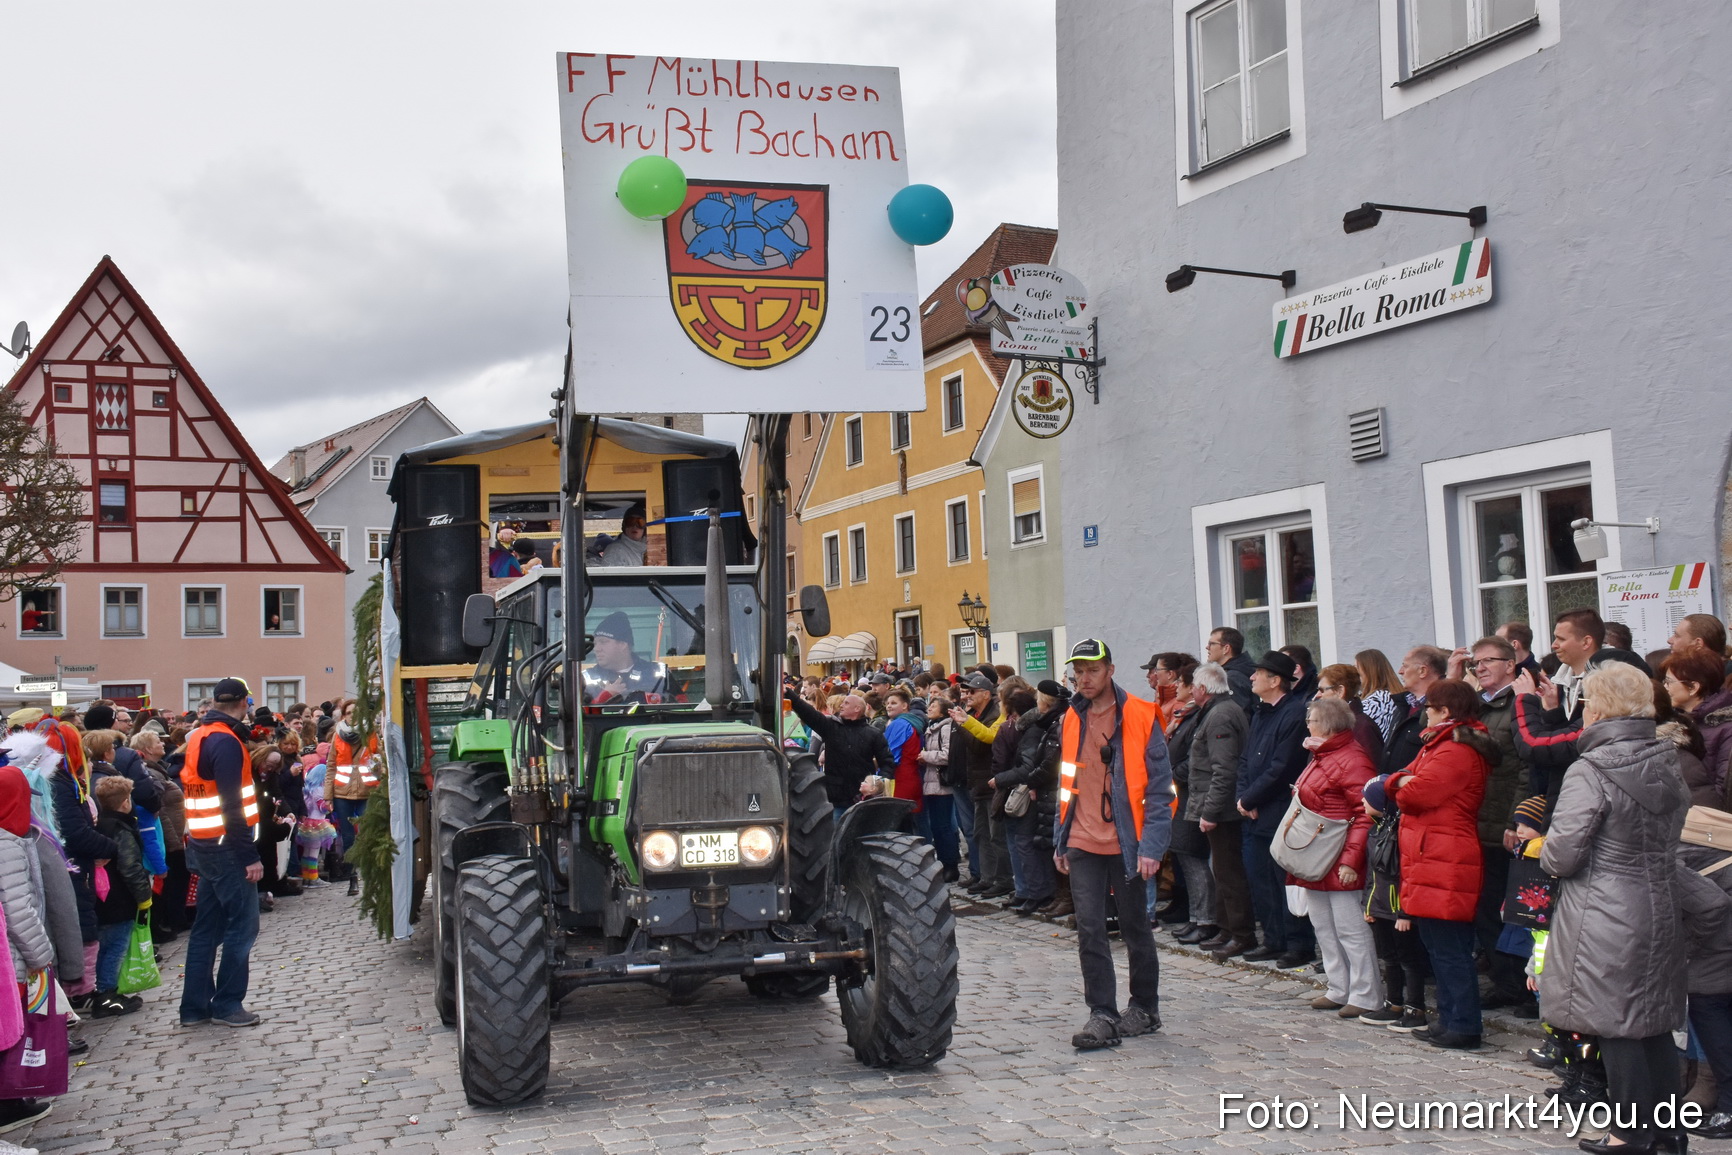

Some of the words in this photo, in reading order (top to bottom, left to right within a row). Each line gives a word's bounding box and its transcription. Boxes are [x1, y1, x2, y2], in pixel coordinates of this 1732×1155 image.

[647, 56, 879, 102] Mühlhausen
[581, 93, 714, 158] Grüßt
[736, 110, 900, 161] Bacham
[1013, 267, 1063, 284] Pizzeria
[1312, 286, 1352, 306] Pizzeria
[1364, 274, 1389, 291] Café
[1399, 258, 1444, 281] Eisdiele
[1026, 287, 1052, 301] Café
[1012, 303, 1065, 321] Eisdiele
[1306, 304, 1366, 343] Bella
[1373, 287, 1447, 325] Roma
[869, 305, 911, 343] 23
[997, 340, 1037, 351] Roma
[1023, 333, 1059, 344] Bella
[1030, 421, 1058, 430] BERCHING
[1087, 527, 1094, 538] 19
[1607, 582, 1643, 593] Bella
[1620, 591, 1660, 602] Roma
[699, 834, 721, 848] NM
[685, 850, 705, 863] CD
[713, 848, 736, 862] 318
